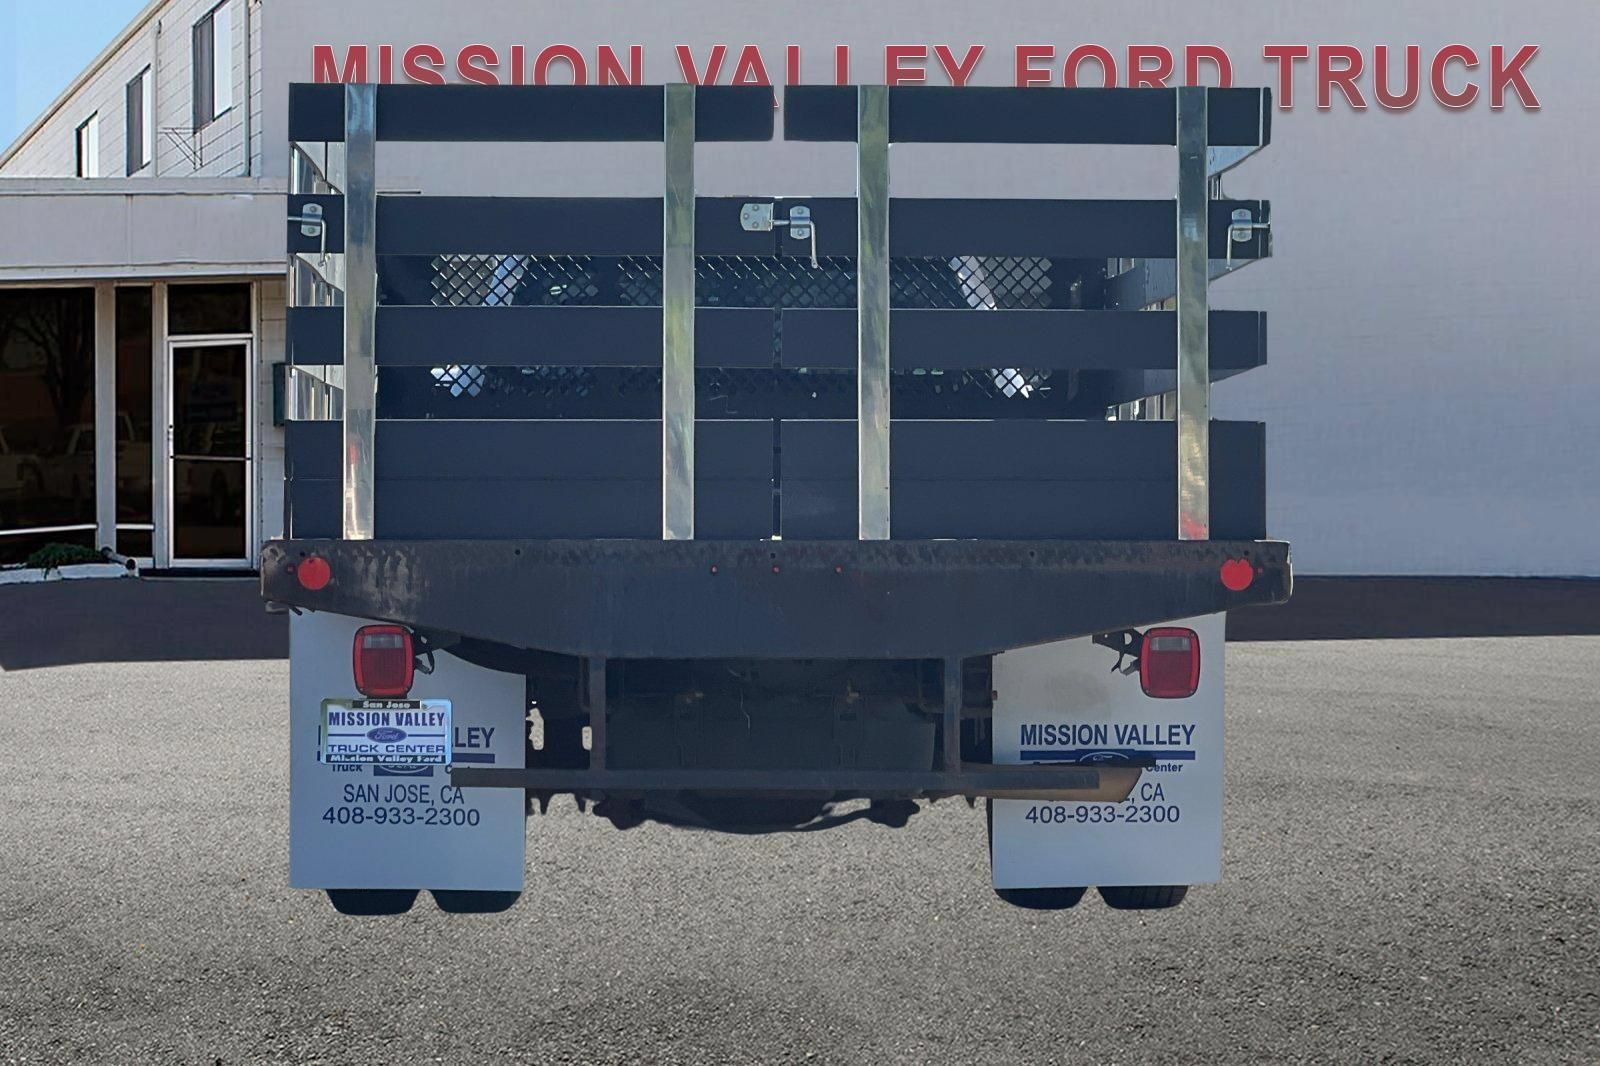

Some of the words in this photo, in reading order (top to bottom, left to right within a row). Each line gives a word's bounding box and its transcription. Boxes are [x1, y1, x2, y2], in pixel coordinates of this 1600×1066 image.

[312, 44, 644, 85] MISSION
[1262, 43, 1541, 110] TRUCK
[362, 701, 382, 709] San
[328, 712, 390, 726] MISSION
[395, 712, 445, 726] VALLEY
[374, 730, 399, 740] Ford
[453, 727, 495, 748] LEY
[1020, 724, 1107, 745] MISSION
[1114, 724, 1196, 745] VALLEY
[328, 744, 379, 753] TRUCK
[385, 744, 445, 753] CENTER
[377, 755, 413, 763] Valley
[343, 784, 379, 803] SAN
[384, 784, 435, 806] JOSE,
[440, 785, 465, 804] CA
[1140, 783, 1165, 801] CA
[322, 806, 481, 826] 408-933-2300
[1025, 805, 1180, 824] 408-933-2300
